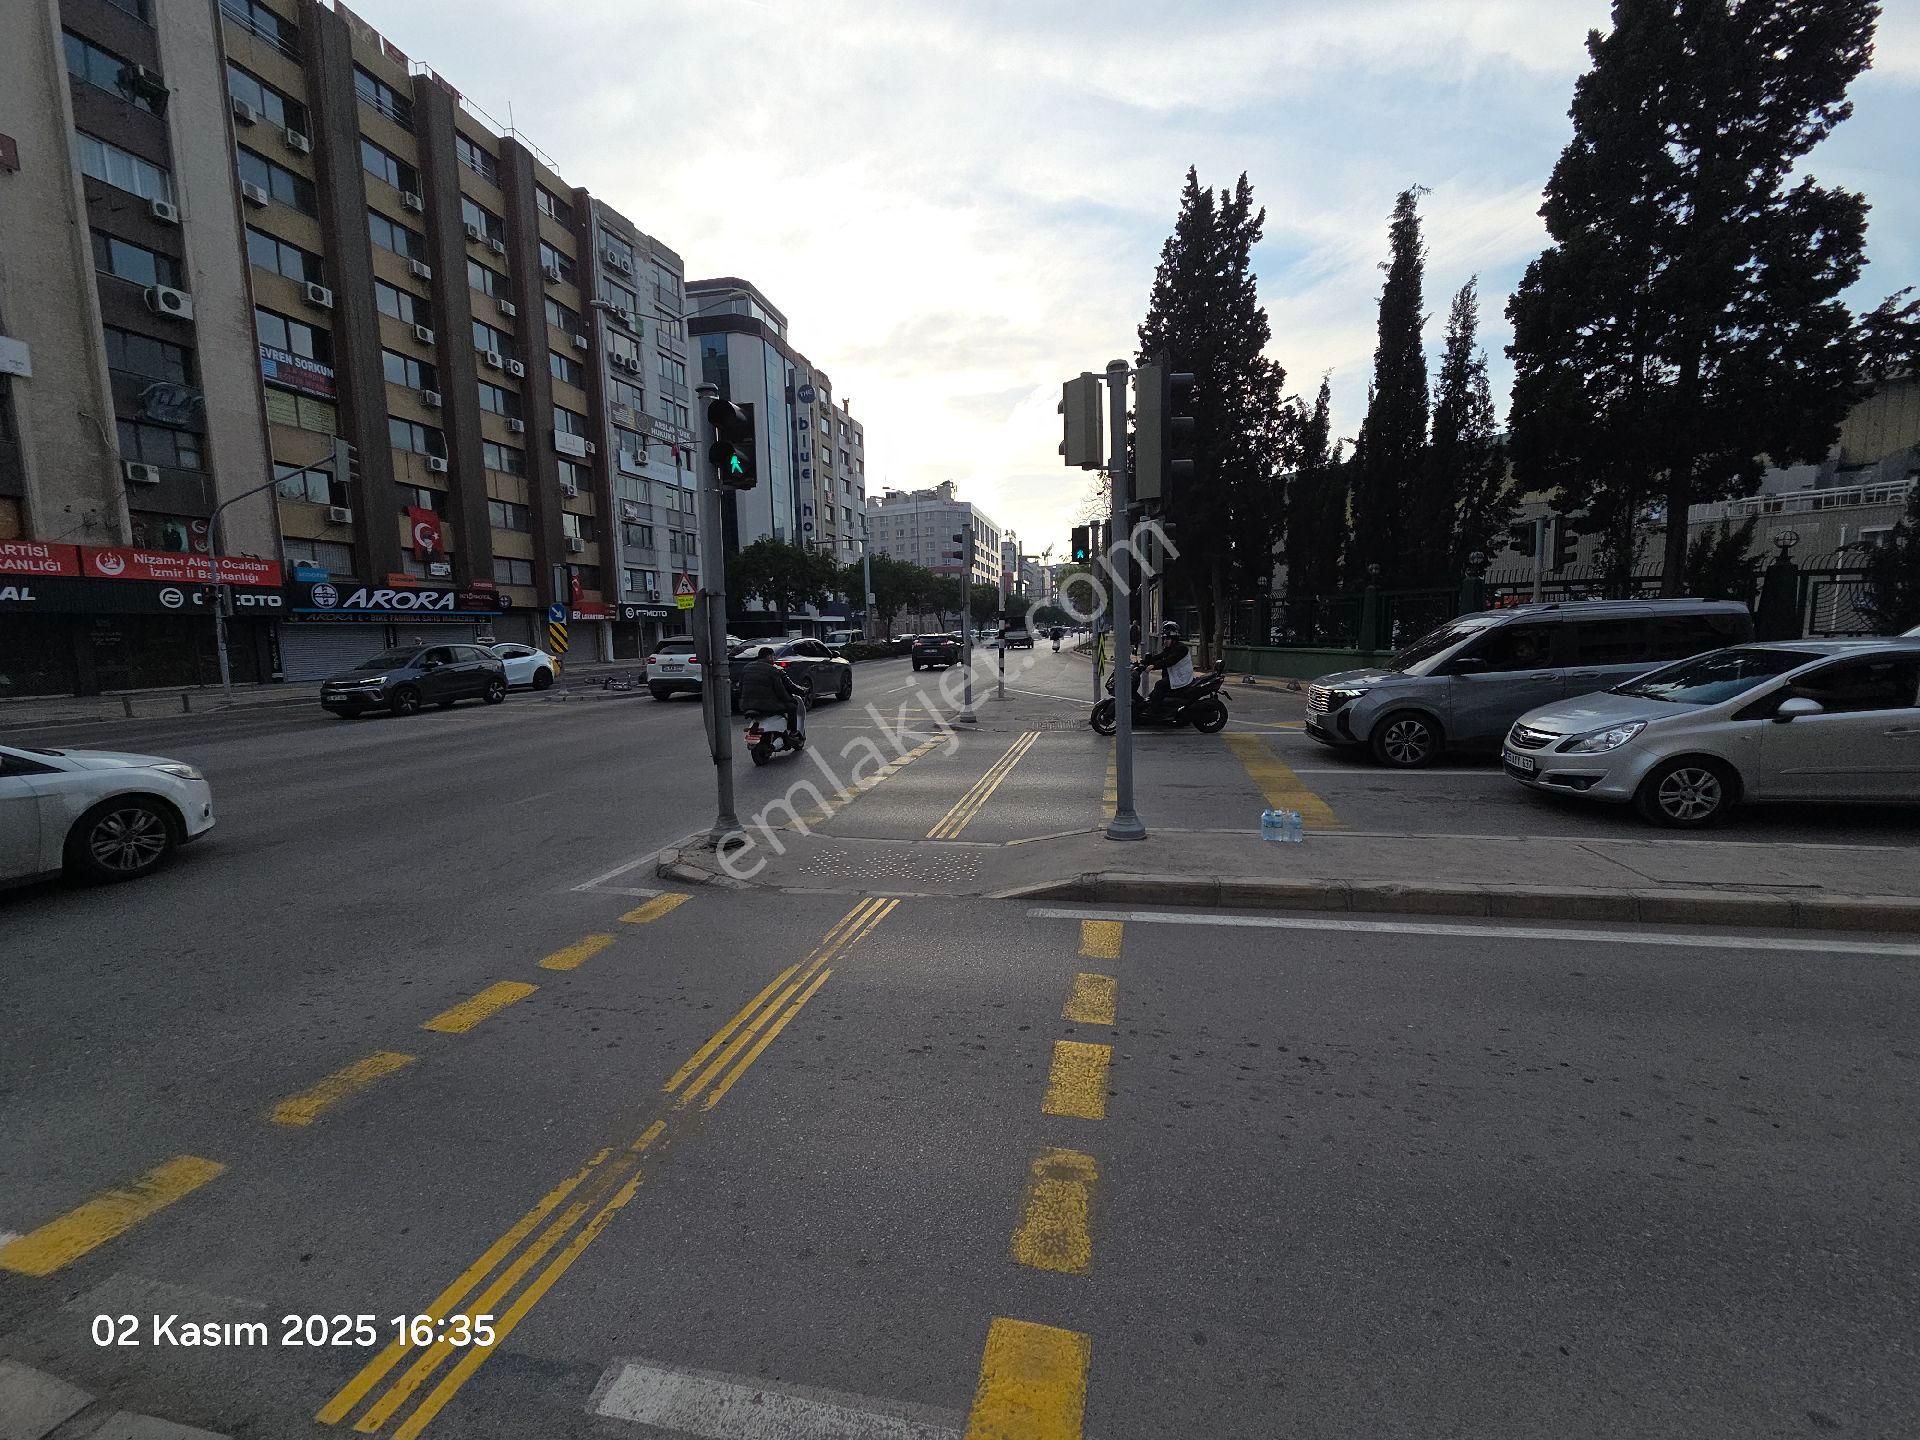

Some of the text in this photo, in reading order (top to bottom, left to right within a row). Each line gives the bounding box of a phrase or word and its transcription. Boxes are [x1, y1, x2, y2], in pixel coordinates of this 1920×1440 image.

[259, 346, 293, 366] EVREN
[294, 357, 335, 378] SORKUN
[799, 416, 811, 479] blue
[149, 565, 183, 578] İzmir
[0, 586, 37, 601] AL
[192, 592, 283, 607] COTO
[342, 587, 455, 611] ARORA
